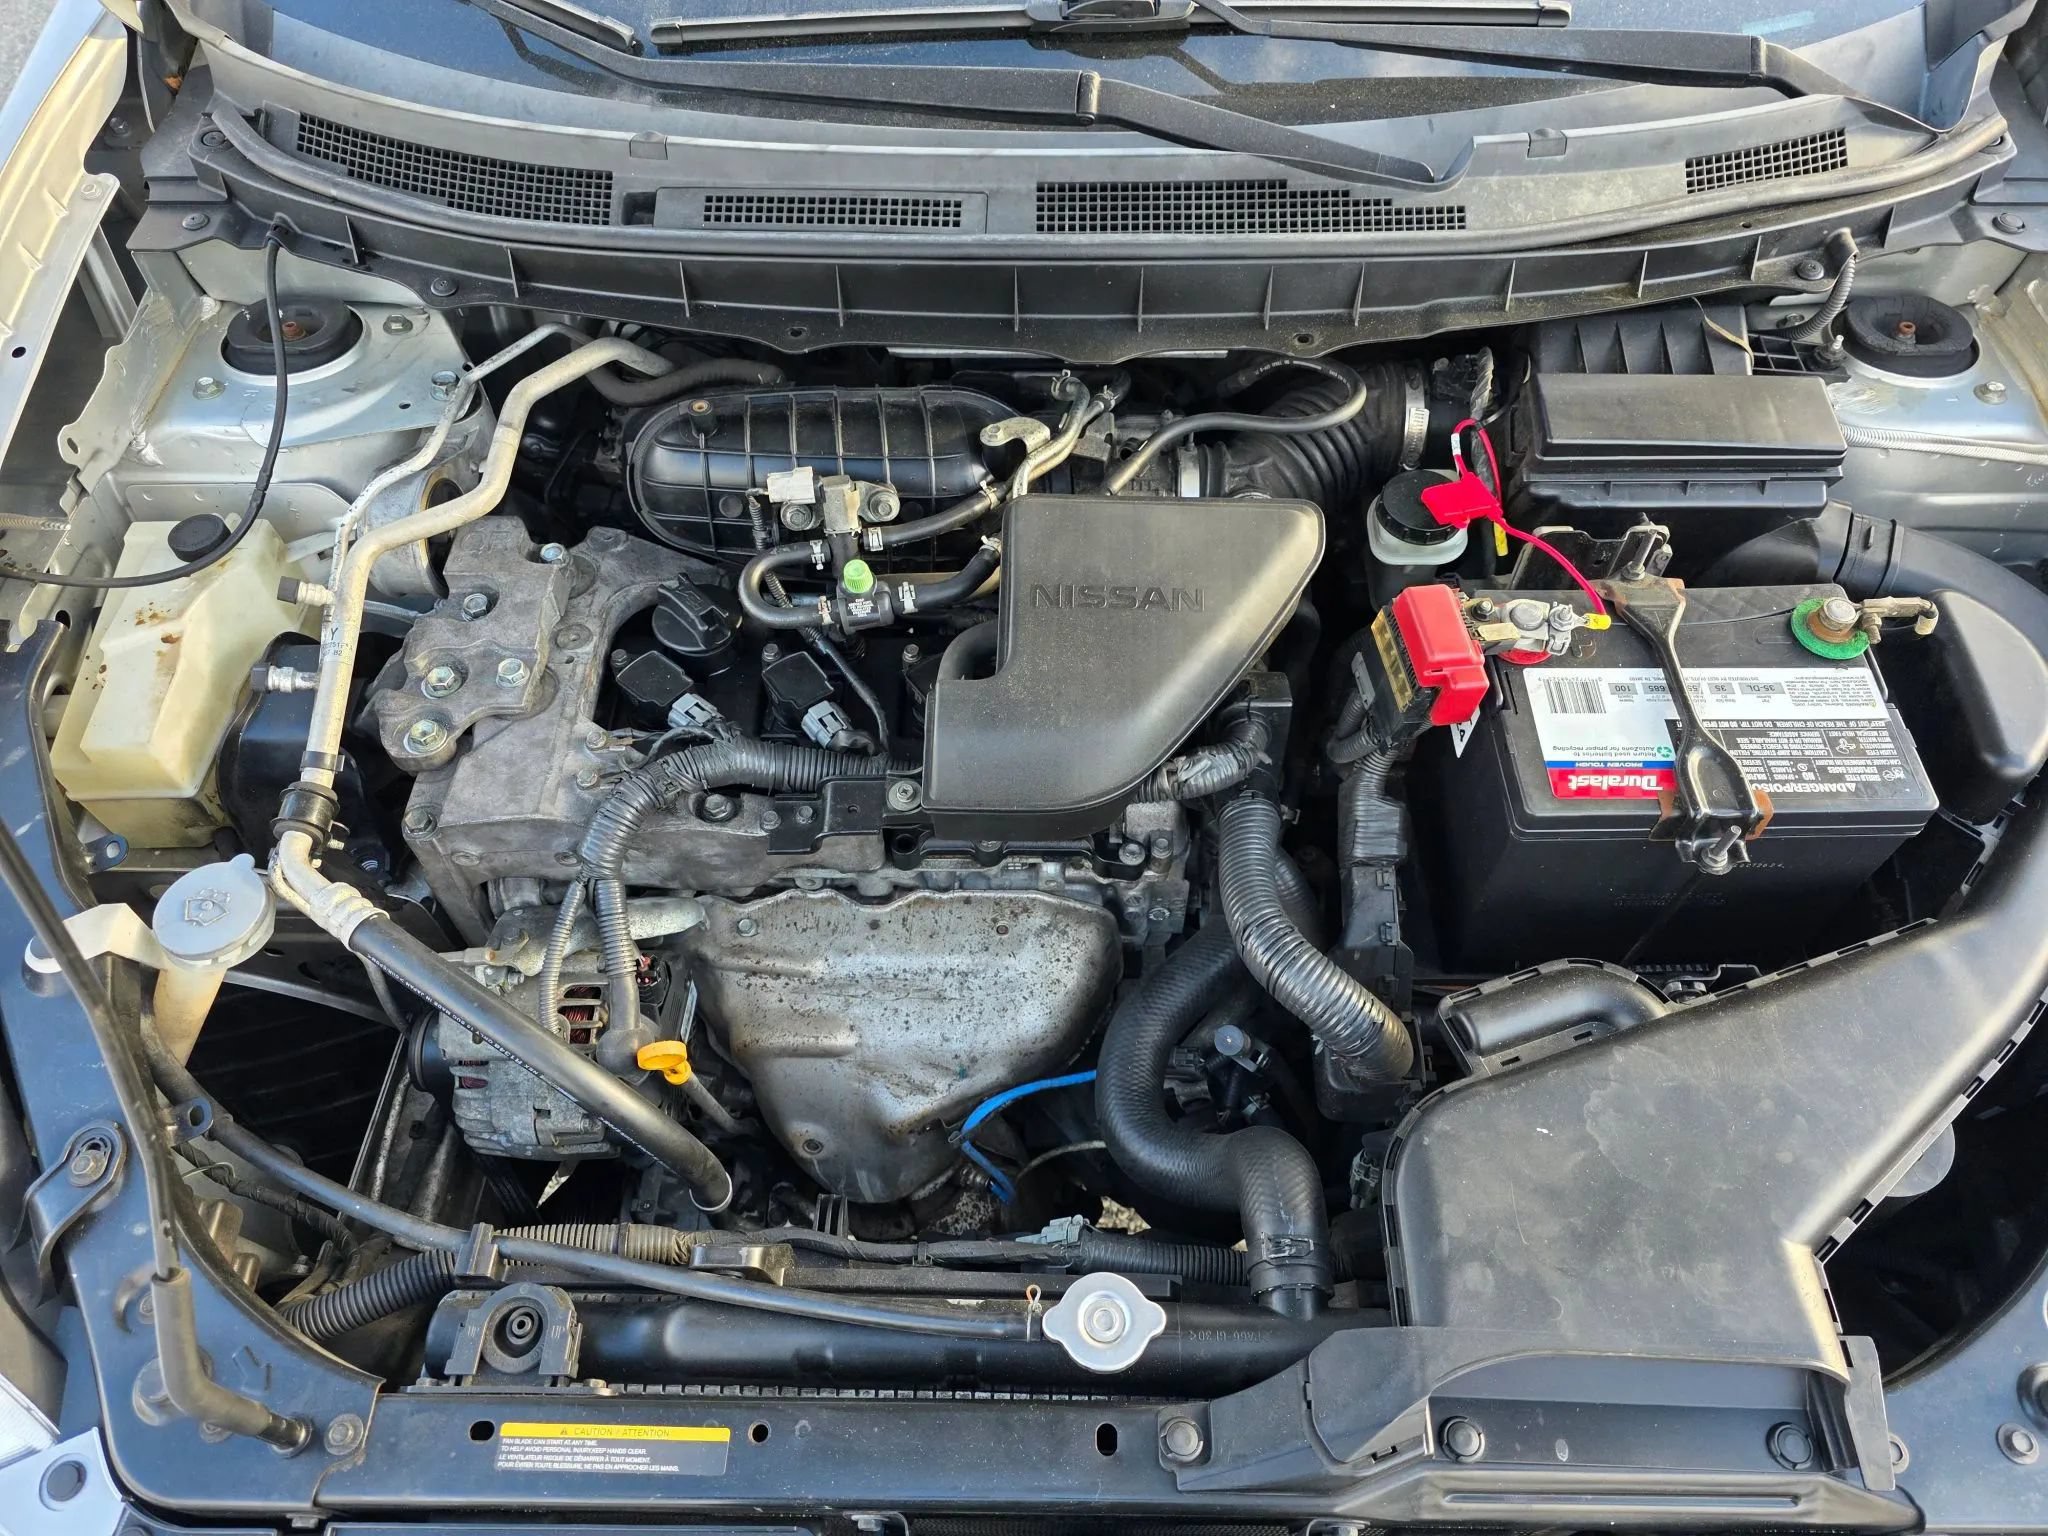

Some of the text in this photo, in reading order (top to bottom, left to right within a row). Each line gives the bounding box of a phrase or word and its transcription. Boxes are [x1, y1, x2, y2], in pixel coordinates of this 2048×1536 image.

[1030, 583, 1205, 612] NISSAN
[1568, 775, 1664, 791] Duralast
[1802, 772, 1816, 780] NO
[1752, 783, 1848, 792] DANGER/POISO
[405, 982, 424, 996] JAPAN
[434, 1001, 451, 1015] MADE
